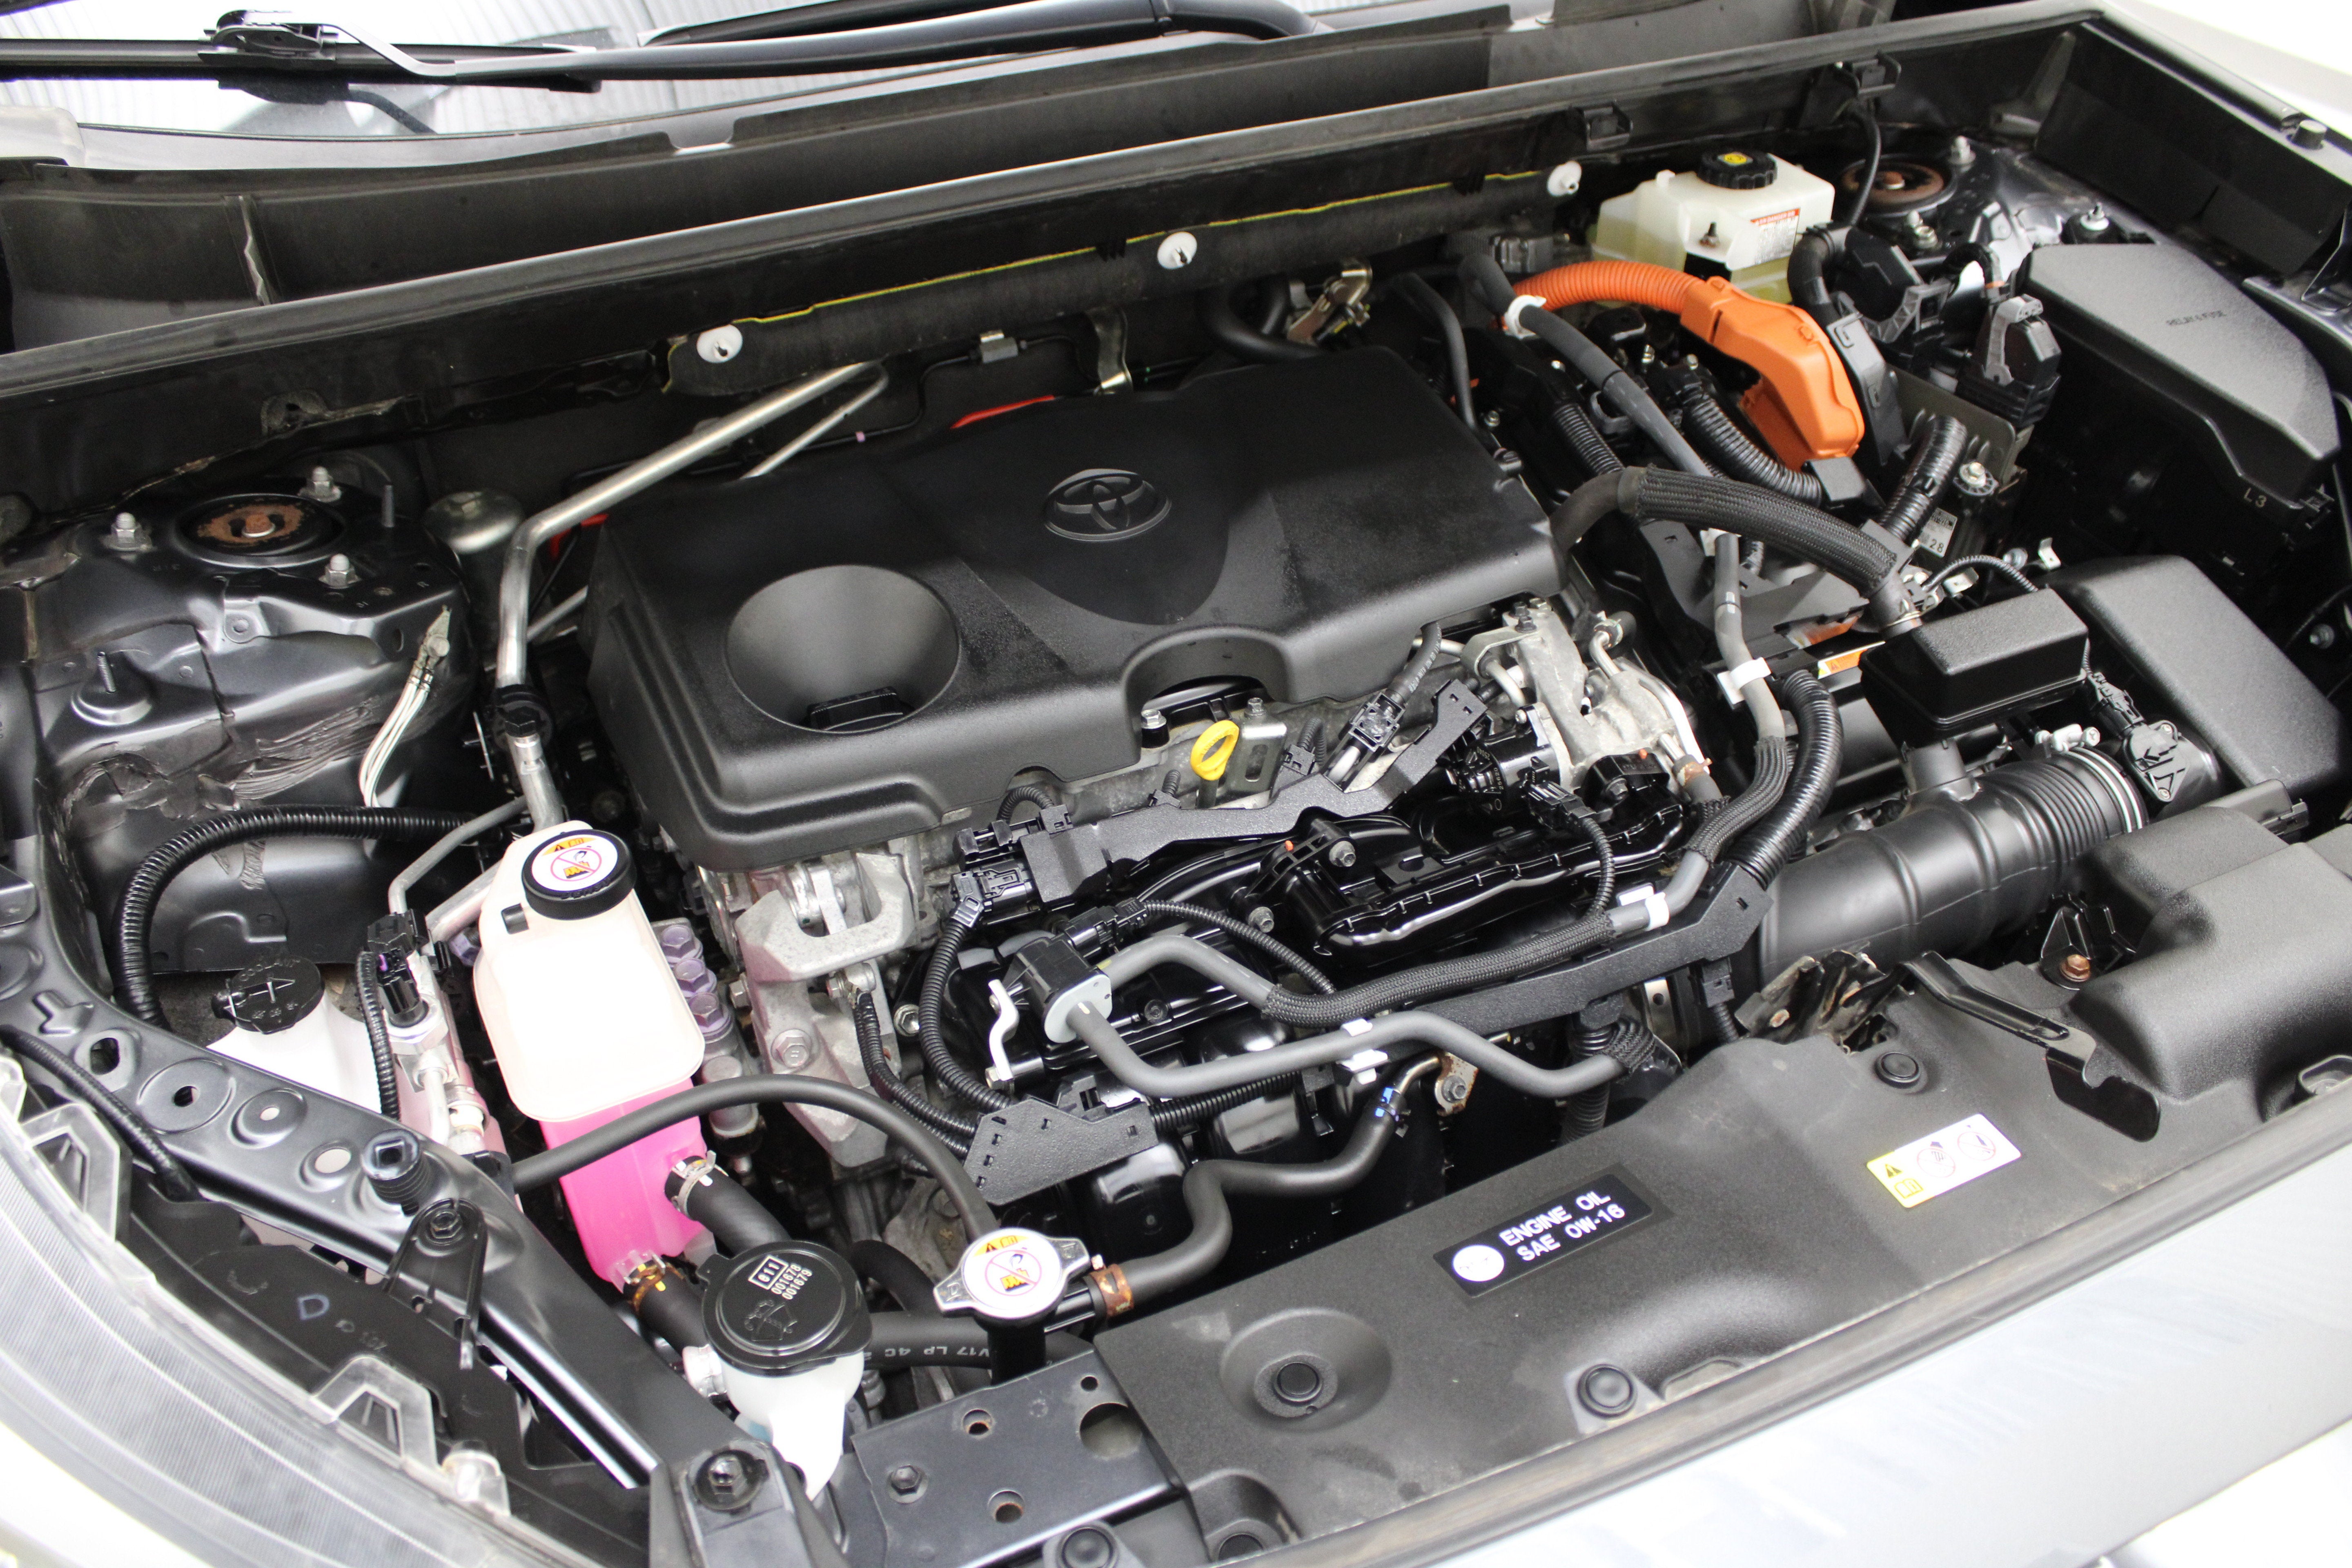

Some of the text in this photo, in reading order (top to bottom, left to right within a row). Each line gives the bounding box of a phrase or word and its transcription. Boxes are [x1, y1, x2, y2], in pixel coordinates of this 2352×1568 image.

[1929, 538, 1944, 553] 28
[1499, 1191, 1611, 1247] ENGINE OIL
[1517, 1233, 1561, 1262] SAE
[757, 1262, 780, 1283] e11
[771, 1263, 802, 1295] 001678
[782, 1269, 813, 1301] 001679
[884, 1345, 990, 1358] V17 LP 4C
